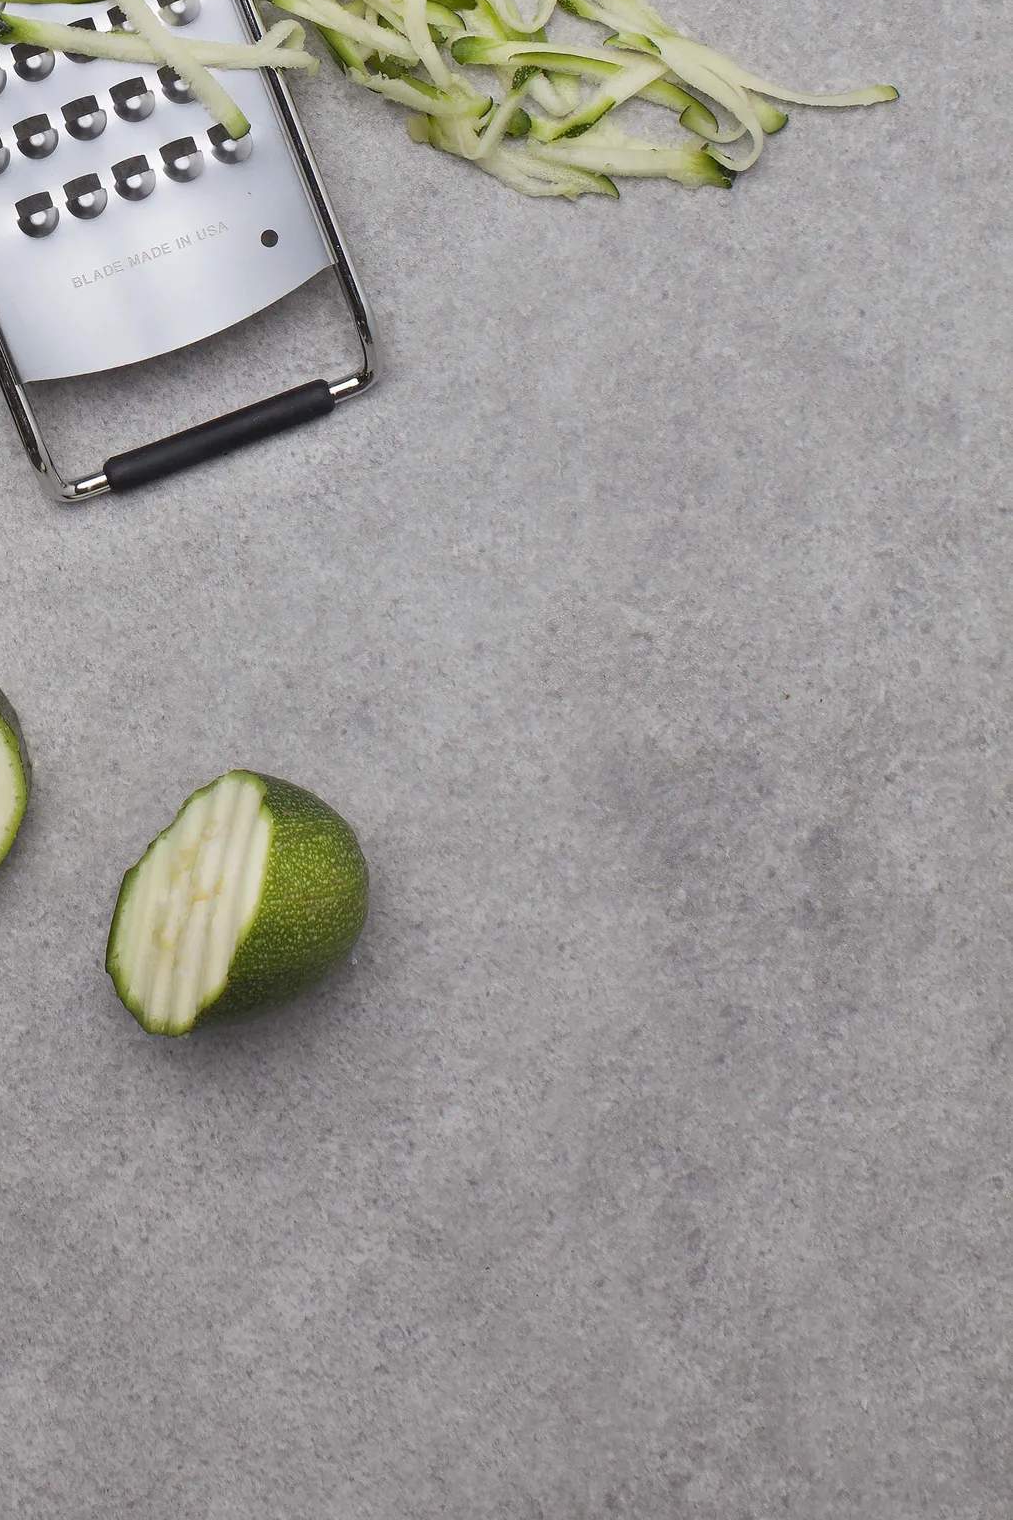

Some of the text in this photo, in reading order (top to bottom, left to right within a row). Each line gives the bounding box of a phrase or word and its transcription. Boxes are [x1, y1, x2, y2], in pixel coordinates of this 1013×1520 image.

[71, 221, 229, 289] BLADE MADE IN USA
